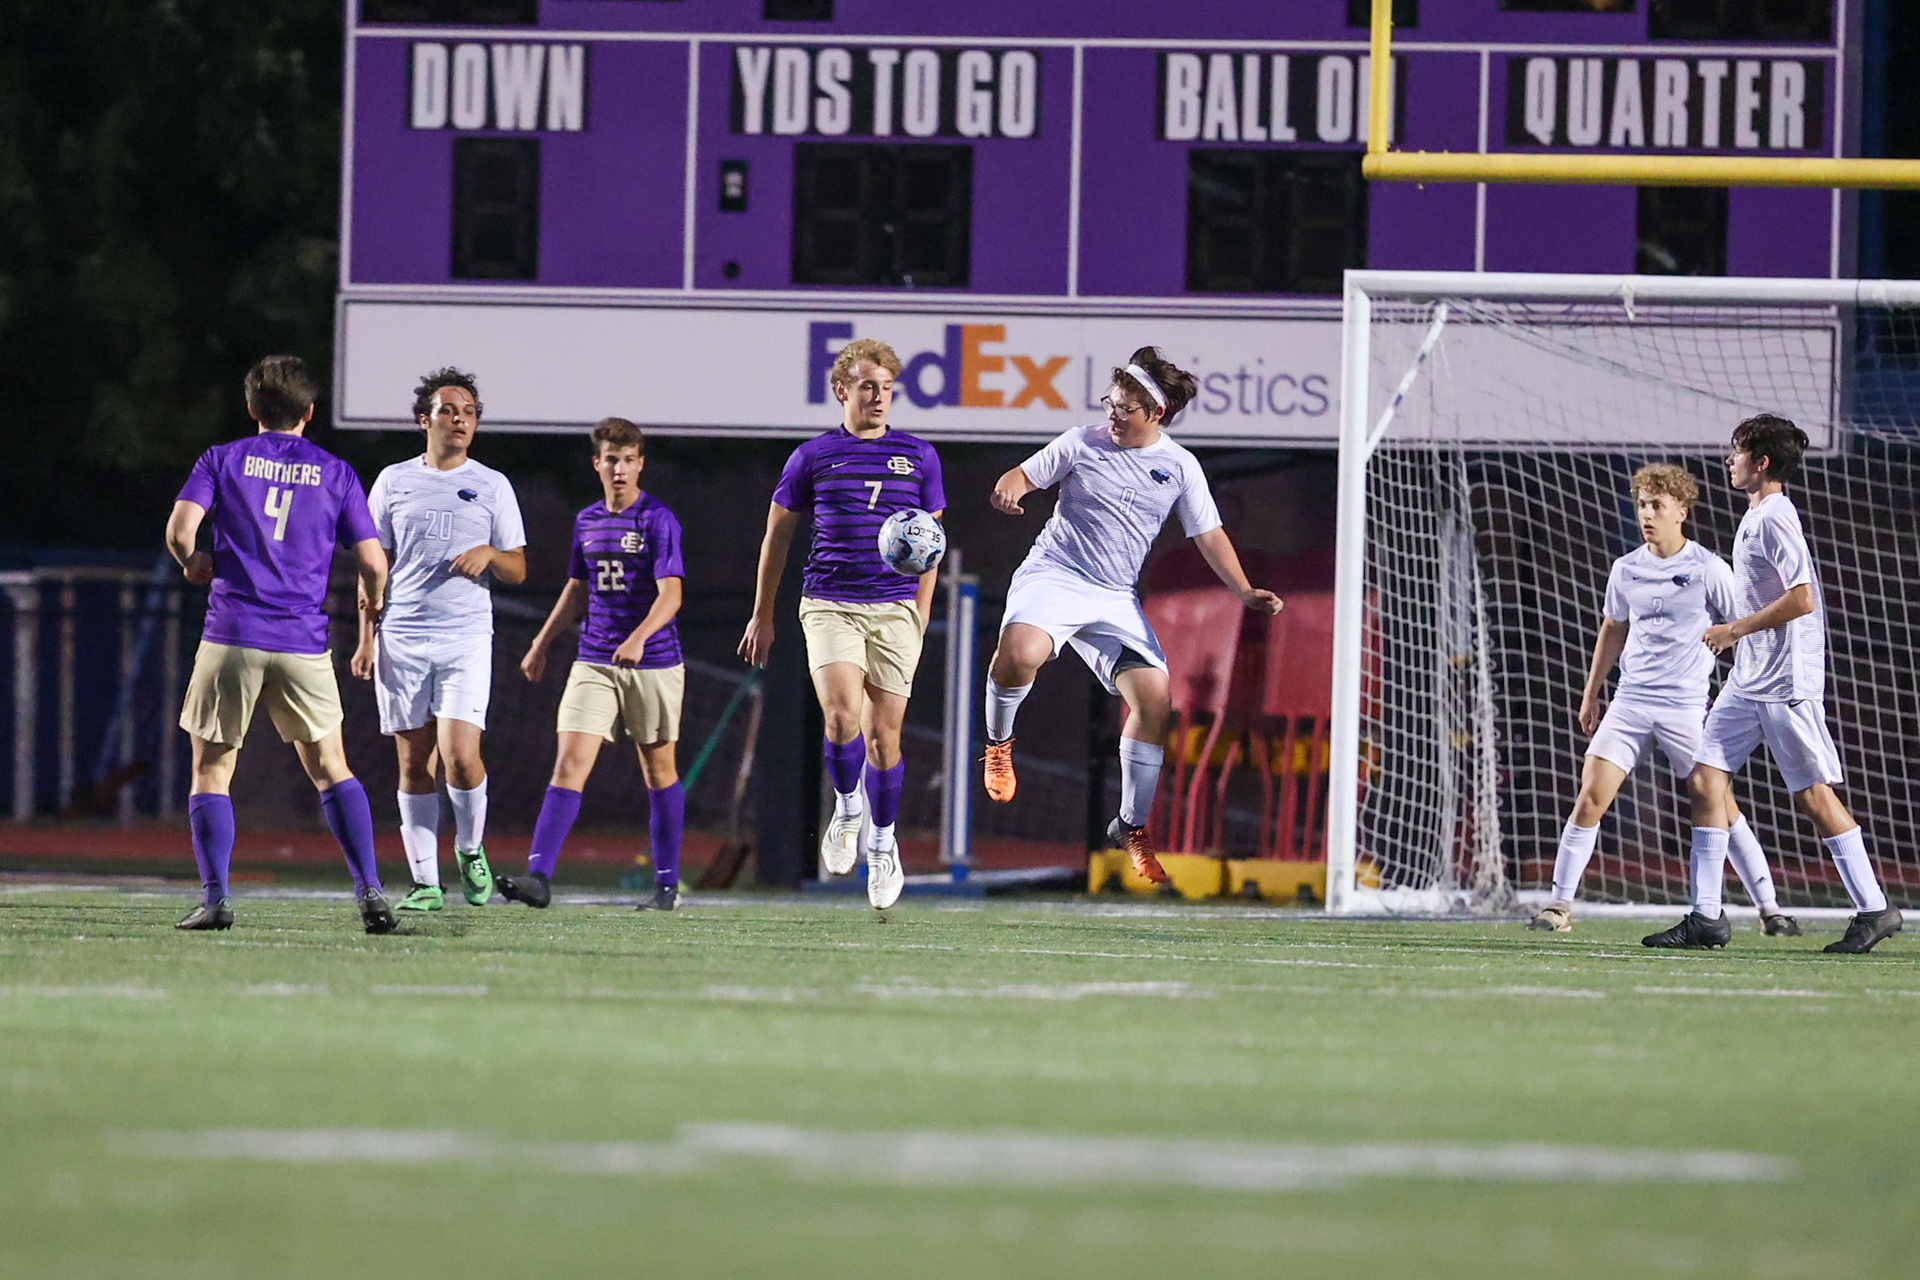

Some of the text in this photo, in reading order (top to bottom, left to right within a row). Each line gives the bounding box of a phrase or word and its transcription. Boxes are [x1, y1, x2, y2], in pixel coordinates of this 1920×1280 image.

[412, 42, 584, 132] DOWN
[736, 47, 1037, 138] YDS TO GO
[1165, 53, 1297, 141] BALL
[1524, 57, 1805, 149] QUARTER
[807, 320, 1329, 425] FdEx Listics
[244, 455, 322, 487] BROTHERS
[864, 481, 883, 510] 7
[264, 486, 294, 542] 4
[424, 508, 454, 541] 20
[597, 560, 626, 591] 22
